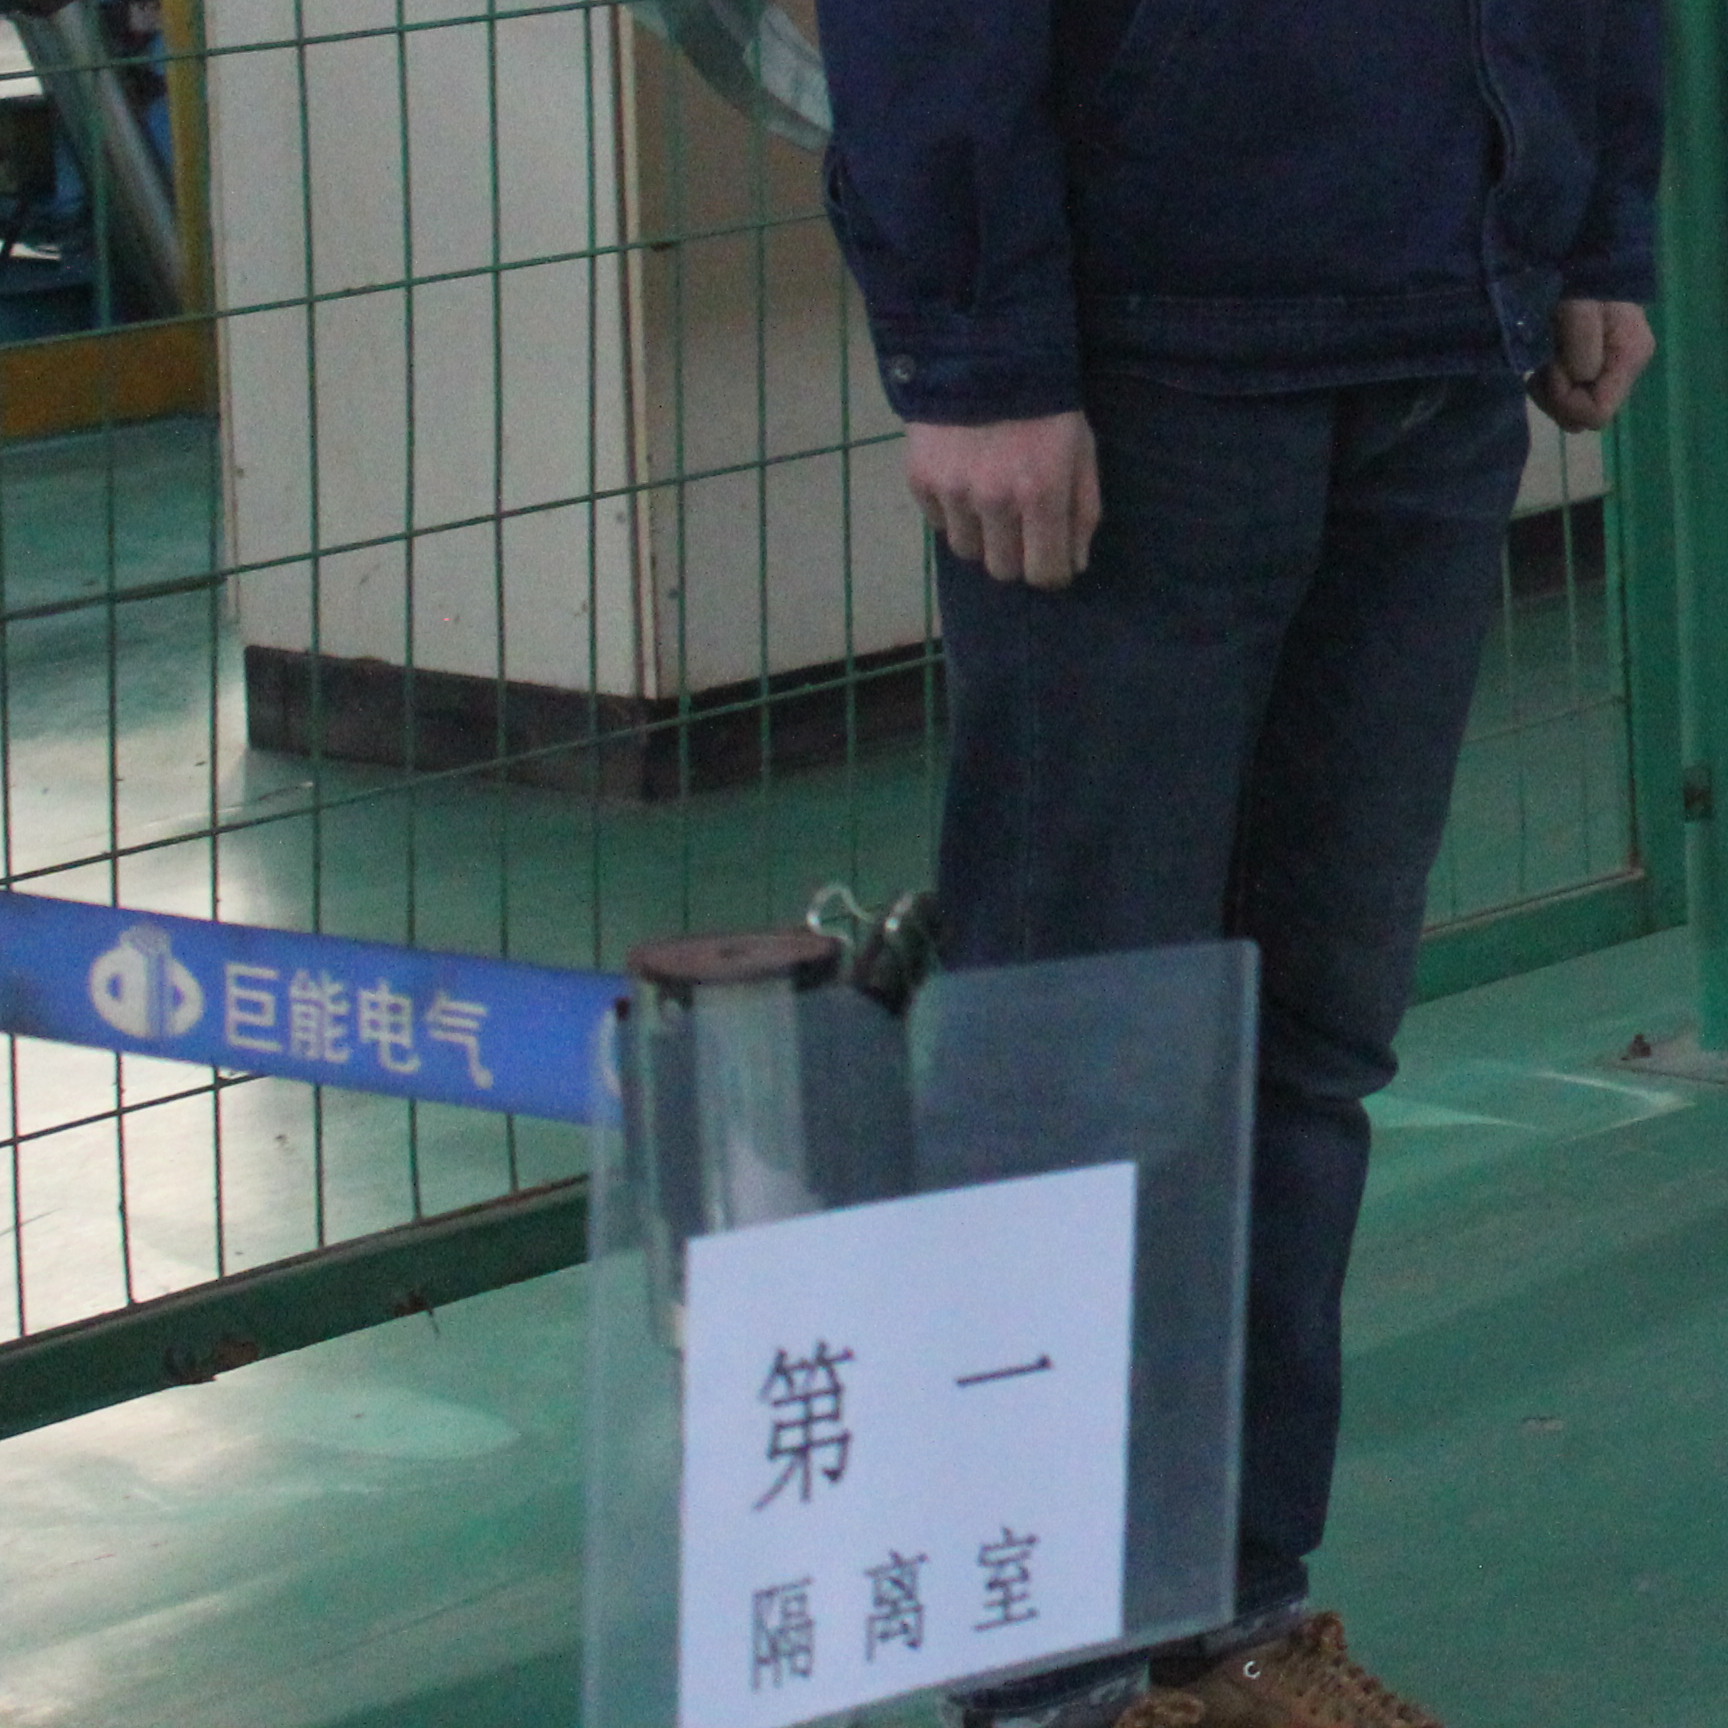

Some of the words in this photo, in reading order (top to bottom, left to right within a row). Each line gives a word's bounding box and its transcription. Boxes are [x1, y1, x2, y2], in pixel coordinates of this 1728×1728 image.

[223, 962, 495, 1091] 巨能电气
[752, 1339, 1053, 1513] 第一
[750, 1526, 1039, 1694] 隔离室
